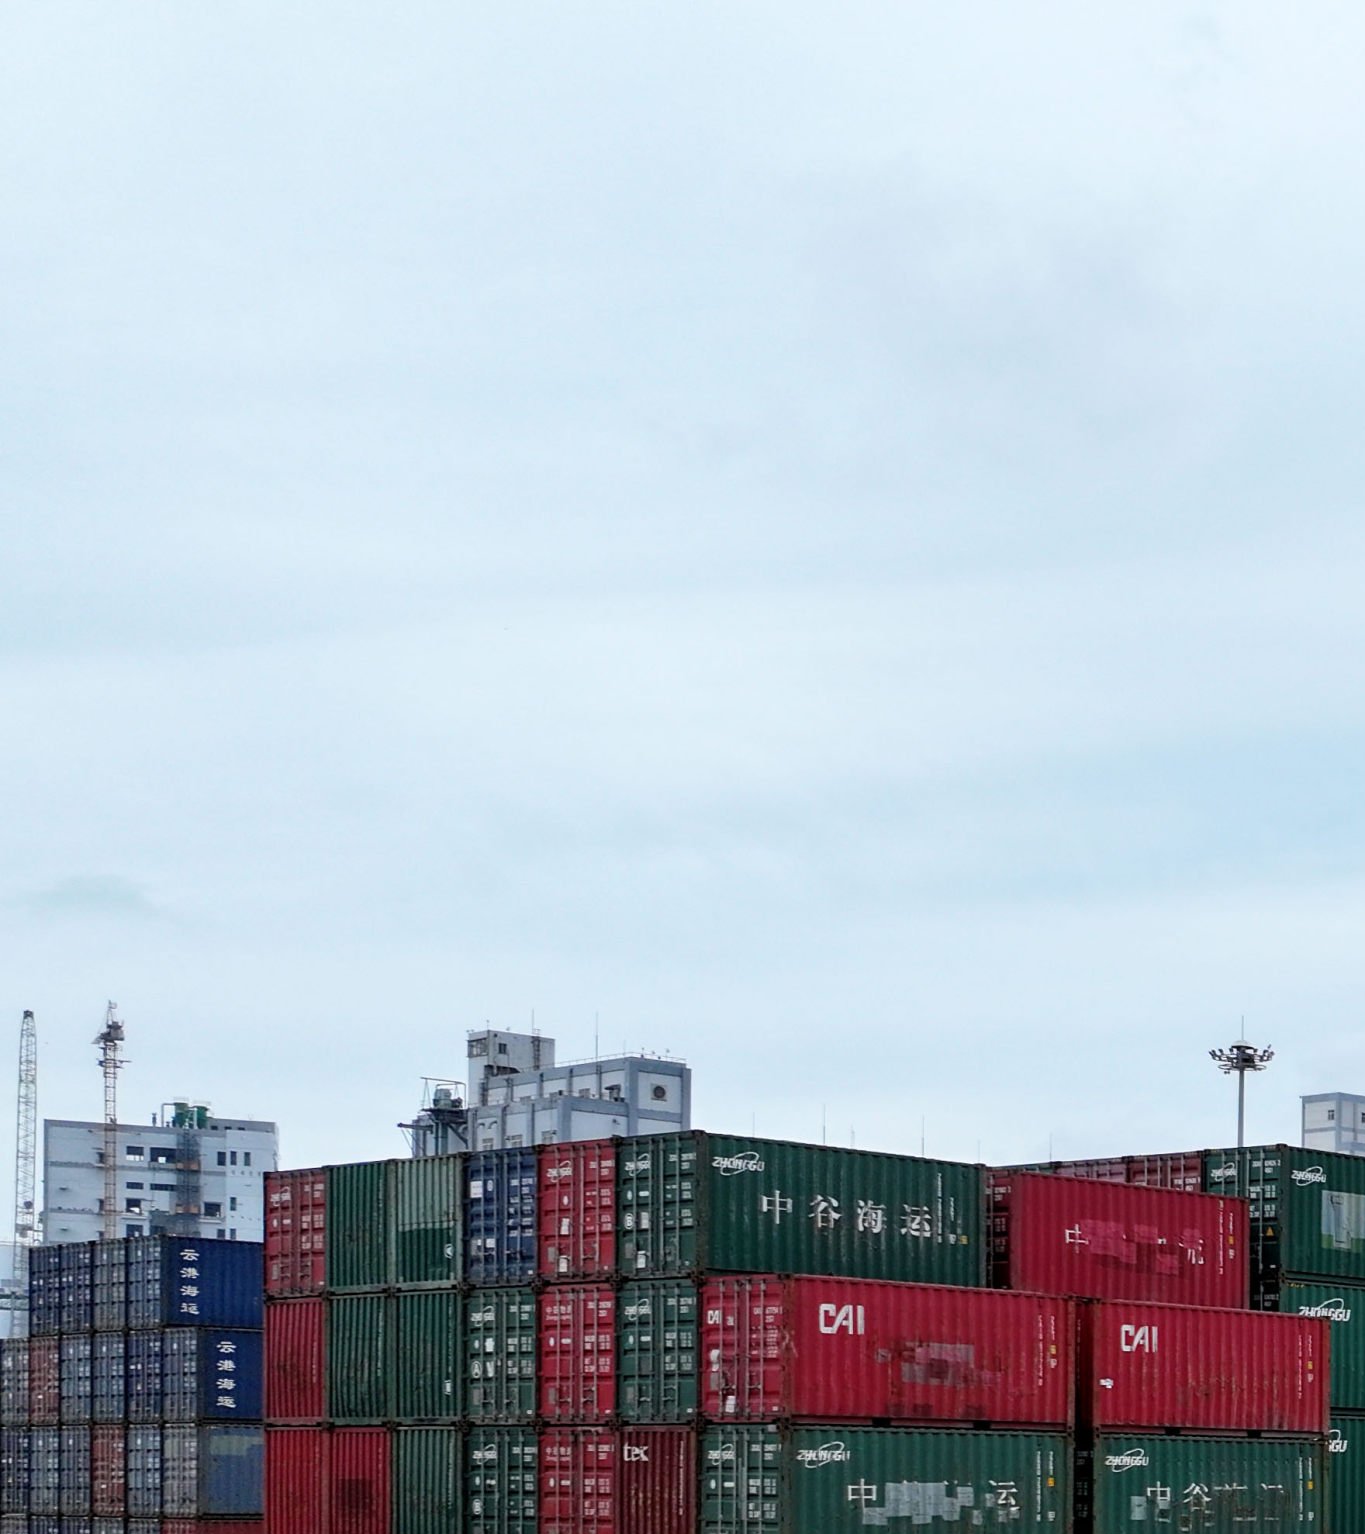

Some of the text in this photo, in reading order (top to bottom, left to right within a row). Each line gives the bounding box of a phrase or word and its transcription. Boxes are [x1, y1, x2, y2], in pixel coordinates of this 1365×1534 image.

[762, 1189, 932, 1238] 中谷海运
[179, 1249, 200, 1315] 云港海运
[819, 1303, 865, 1336] CAI
[1120, 1324, 1158, 1353] CAI
[216, 1341, 237, 1408] 云港海运
